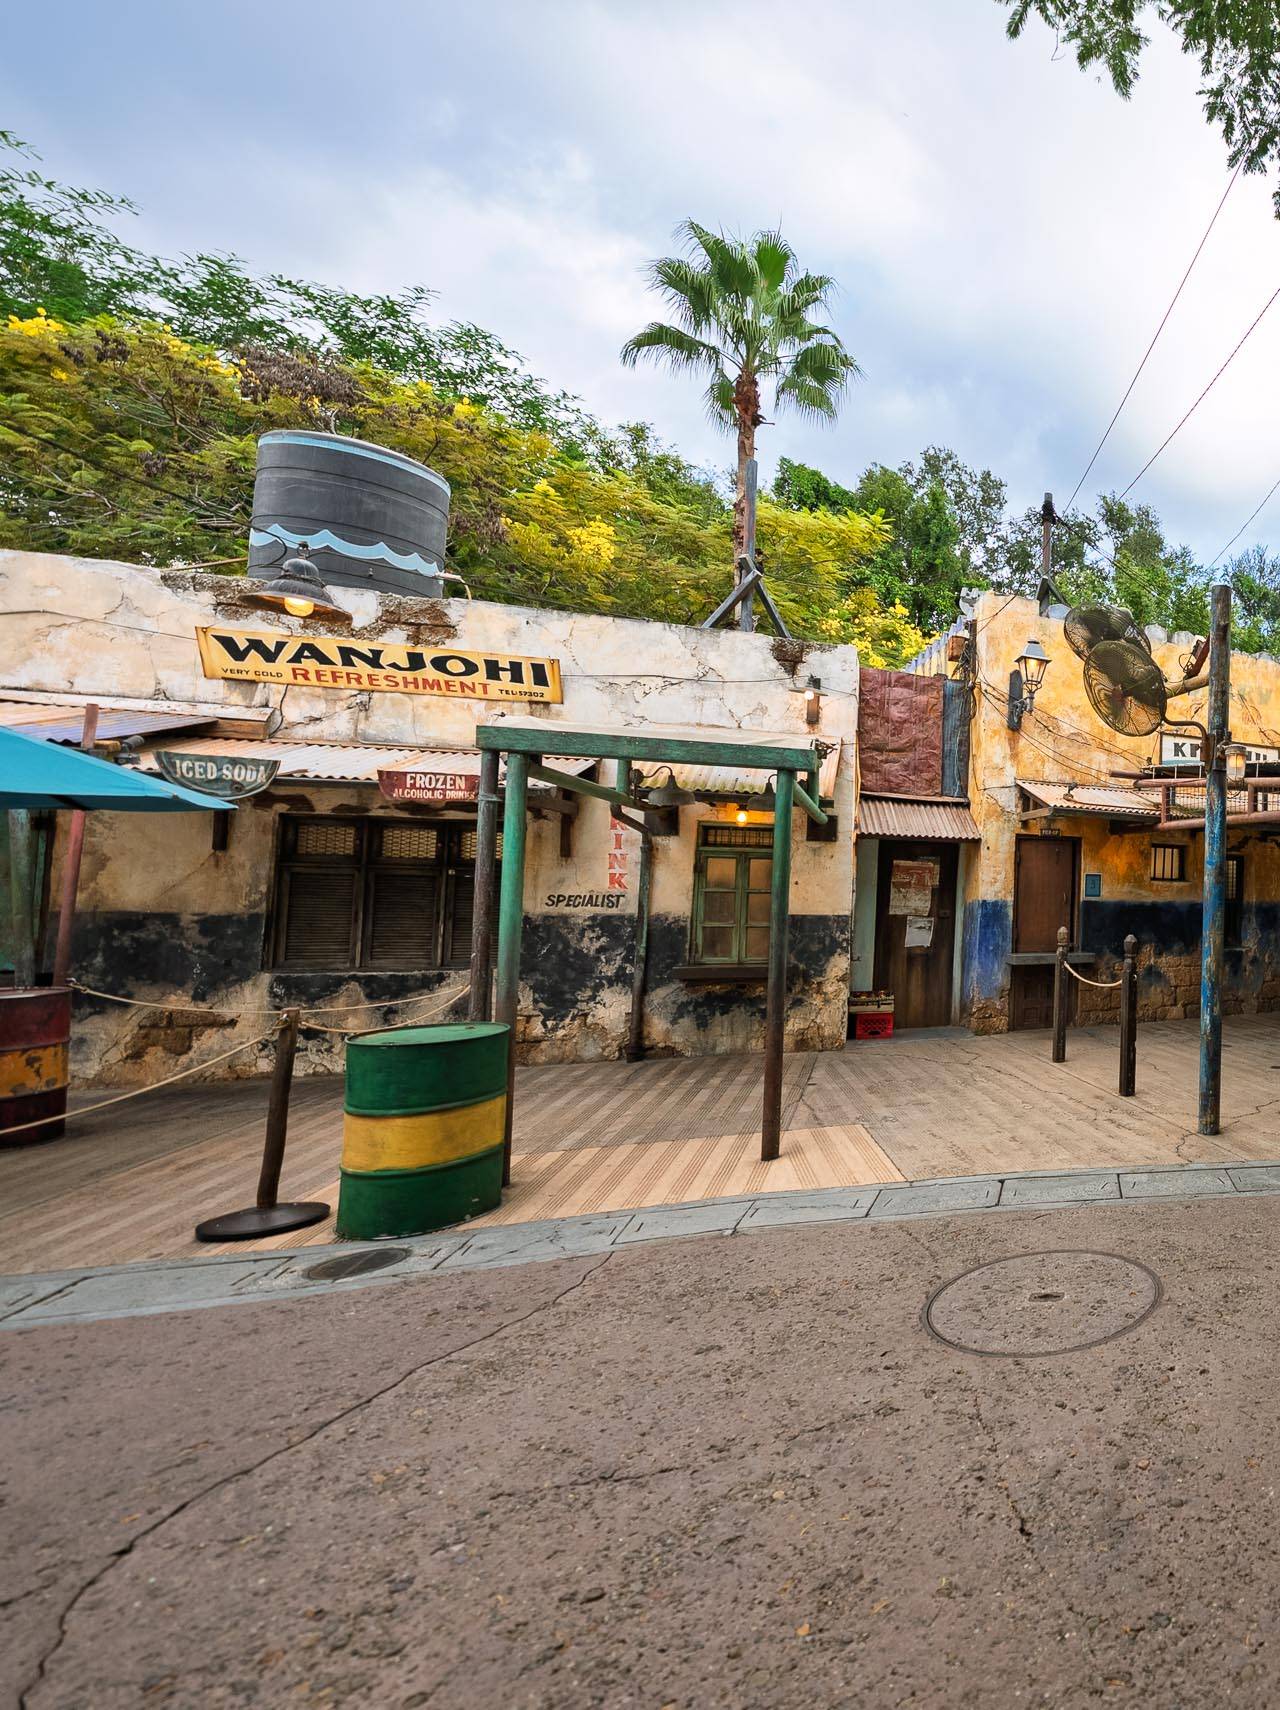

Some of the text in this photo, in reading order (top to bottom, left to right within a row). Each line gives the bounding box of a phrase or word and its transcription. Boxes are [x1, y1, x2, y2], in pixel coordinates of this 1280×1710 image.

[211, 634, 550, 687] WANJOHI
[221, 667, 250, 676] VERY
[254, 670, 283, 678] COLD
[291, 667, 491, 695] REFRESHMENT
[175, 760, 267, 783] ICED SODA
[406, 773, 466, 790] FROZEN
[393, 788, 475, 800] ALCOHOLIC DRINKS
[545, 894, 625, 908] SPECIALIST
